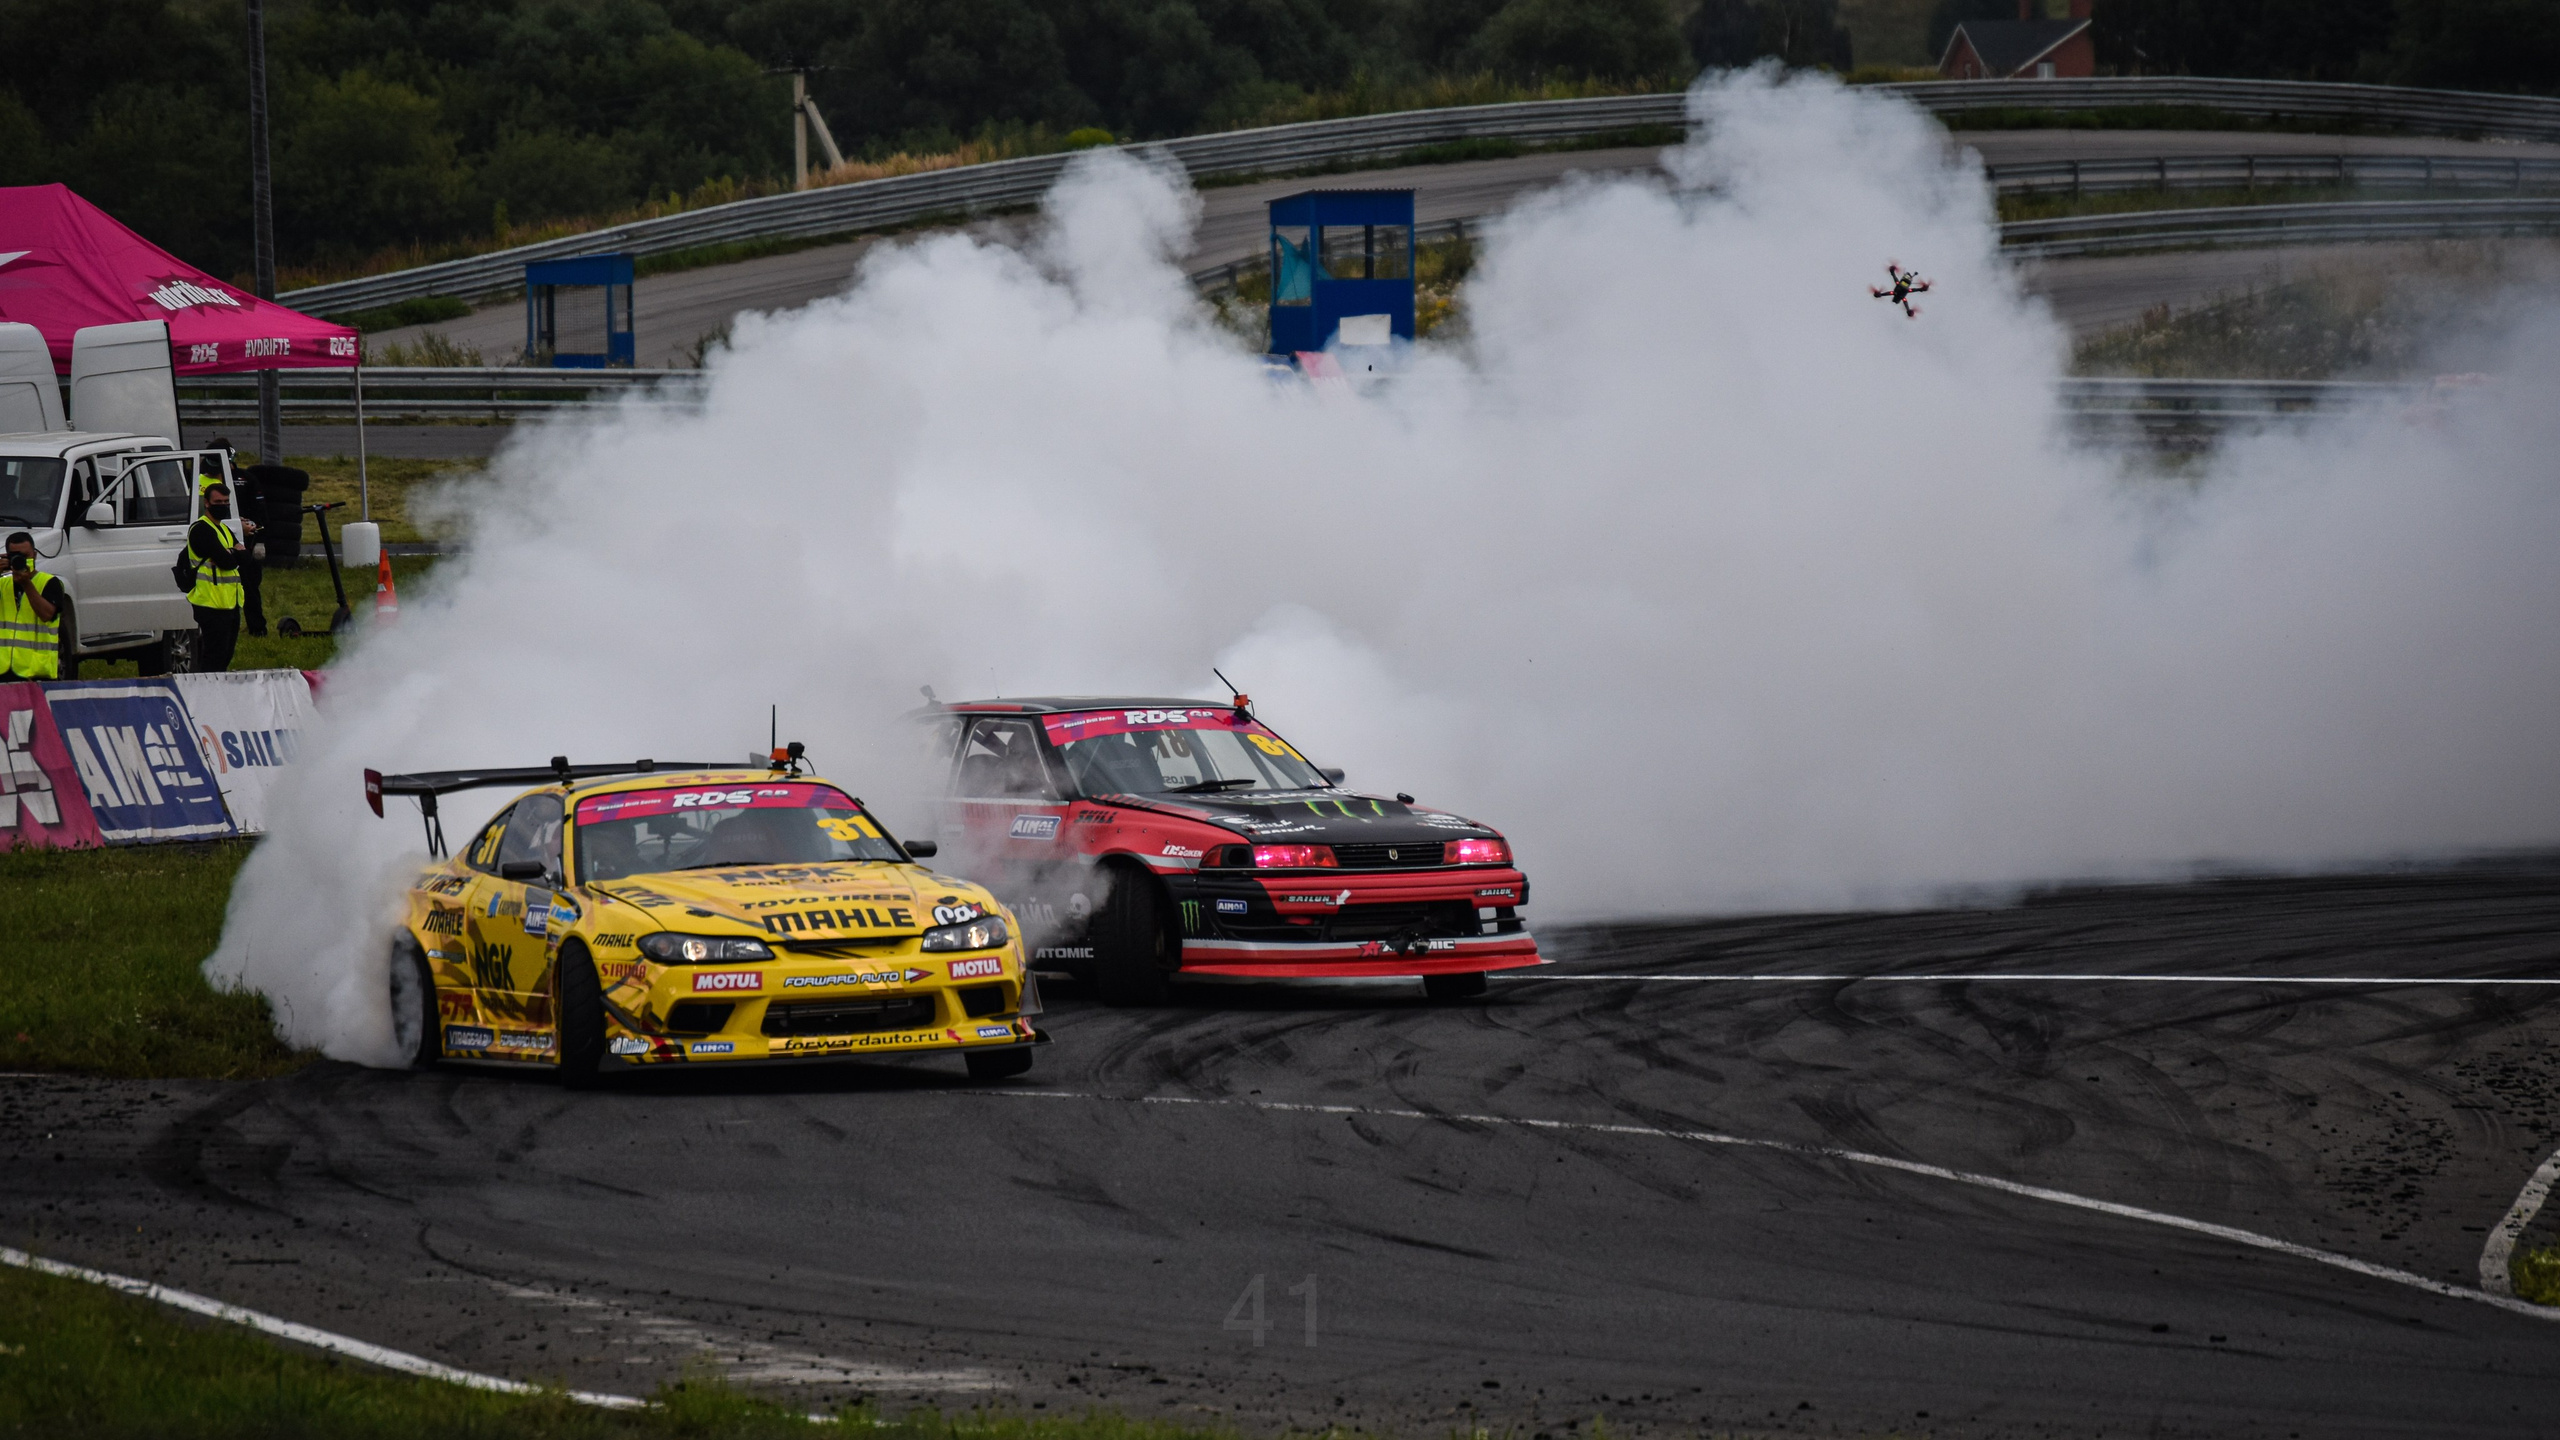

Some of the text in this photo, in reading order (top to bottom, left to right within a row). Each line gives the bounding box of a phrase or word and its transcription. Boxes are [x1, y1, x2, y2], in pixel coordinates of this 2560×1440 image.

[190, 342, 219, 363] RDS
[245, 338, 290, 358] #VDRIFTE
[329, 337, 357, 355] RDS
[1124, 710, 1189, 725] RDS
[221, 729, 303, 769] SAILU
[1247, 734, 1306, 762] 81
[673, 790, 754, 807] RDS
[816, 815, 883, 841] 31
[477, 824, 506, 865] 31
[717, 867, 856, 882] NGK
[740, 894, 911, 910] TOYO TIRES
[422, 910, 464, 936] MAHLE
[761, 907, 916, 934] MAHLE
[593, 933, 635, 947] MAHLE
[1036, 948, 1094, 959] ATOMIC
[474, 942, 515, 992] NGK
[952, 959, 1001, 977] MOTUL
[696, 973, 759, 989] MOTUL
[784, 972, 900, 987] FORWARD AUTO
[784, 1033, 939, 1050] forwardauto.ru
